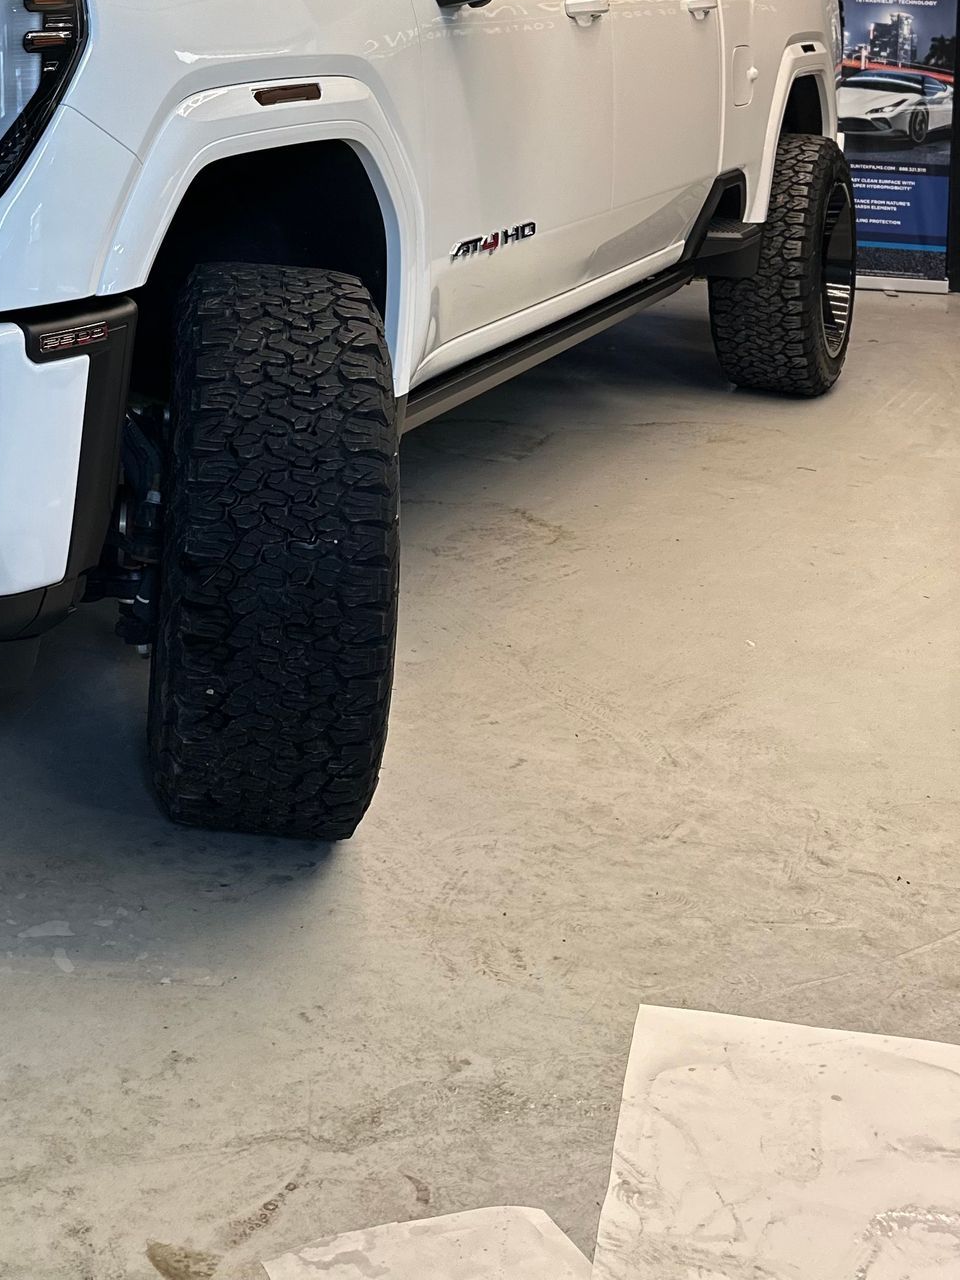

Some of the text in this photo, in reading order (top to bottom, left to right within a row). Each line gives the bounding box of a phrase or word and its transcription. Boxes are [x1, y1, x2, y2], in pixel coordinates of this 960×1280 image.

[449, 221, 536, 260] AT4 HD
[43, 326, 106, 349] 2500
